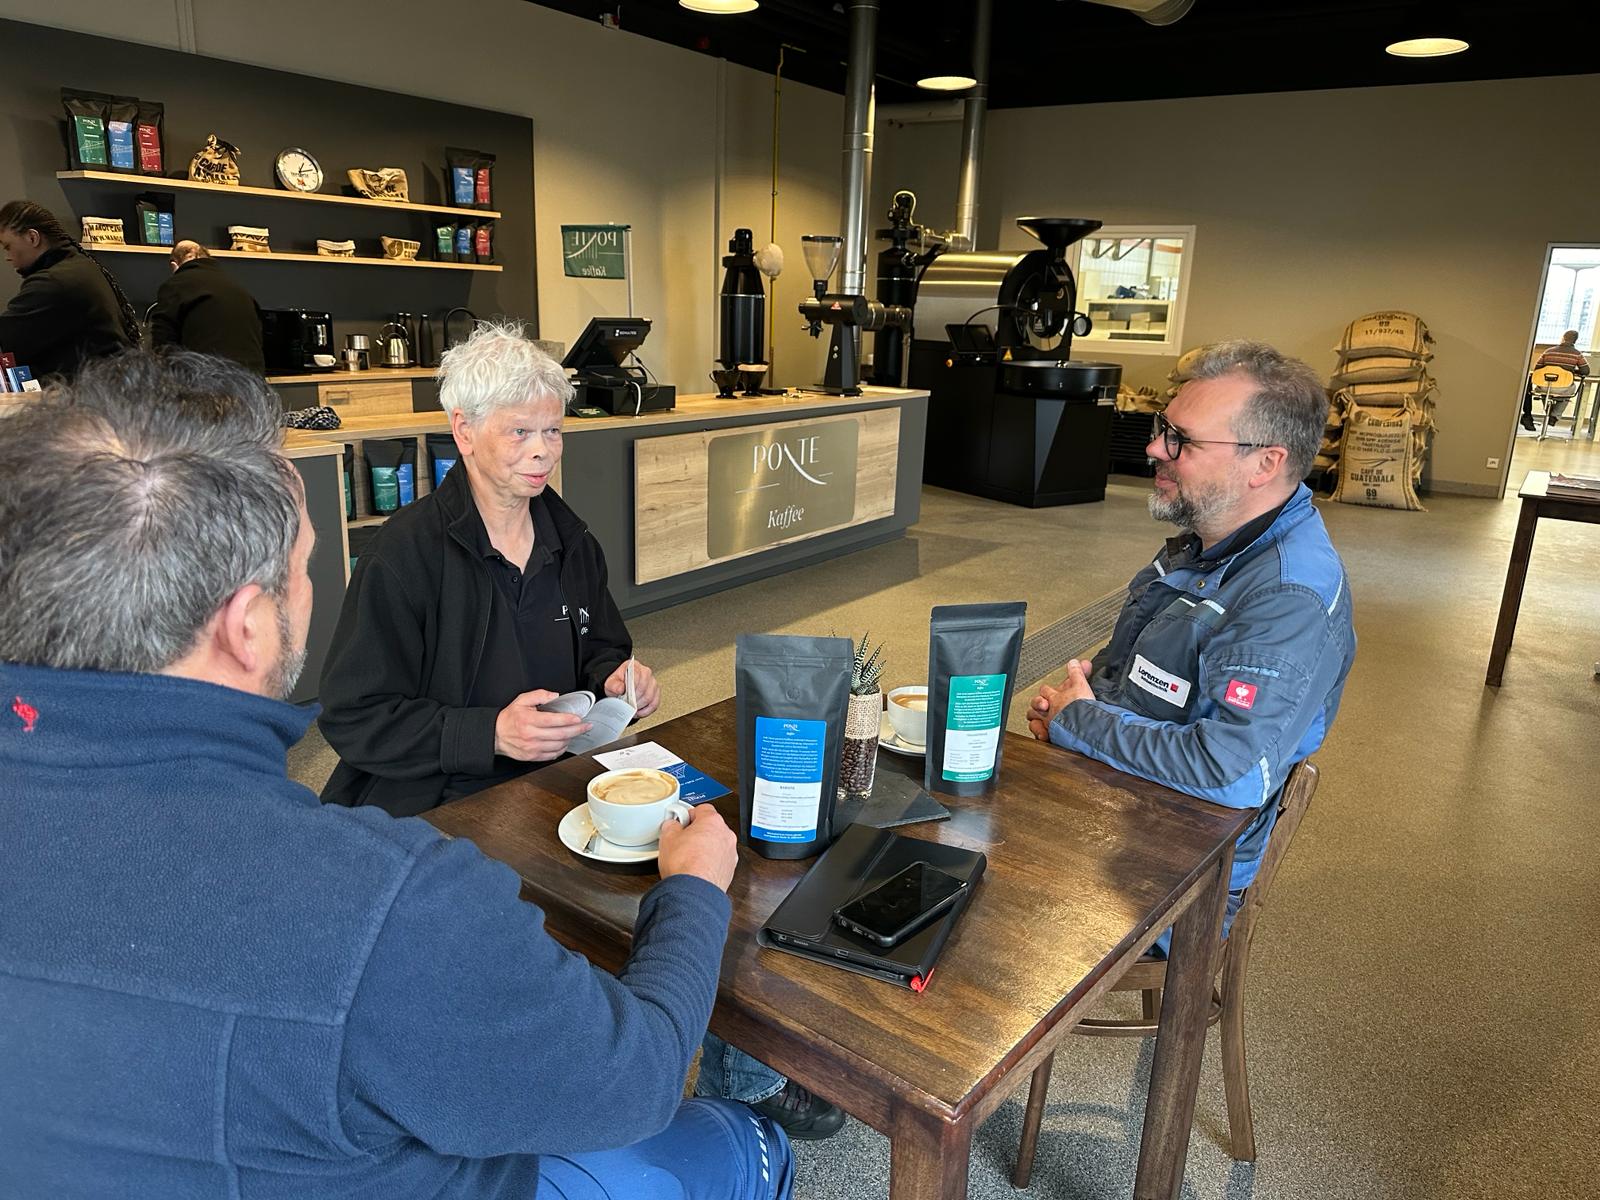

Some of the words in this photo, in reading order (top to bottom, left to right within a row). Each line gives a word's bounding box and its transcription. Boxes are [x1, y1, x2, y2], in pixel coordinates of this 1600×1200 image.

[753, 436, 827, 485] PONTE
[767, 504, 805, 530] Kaffee
[1138, 665, 1169, 688] Lorenzen
